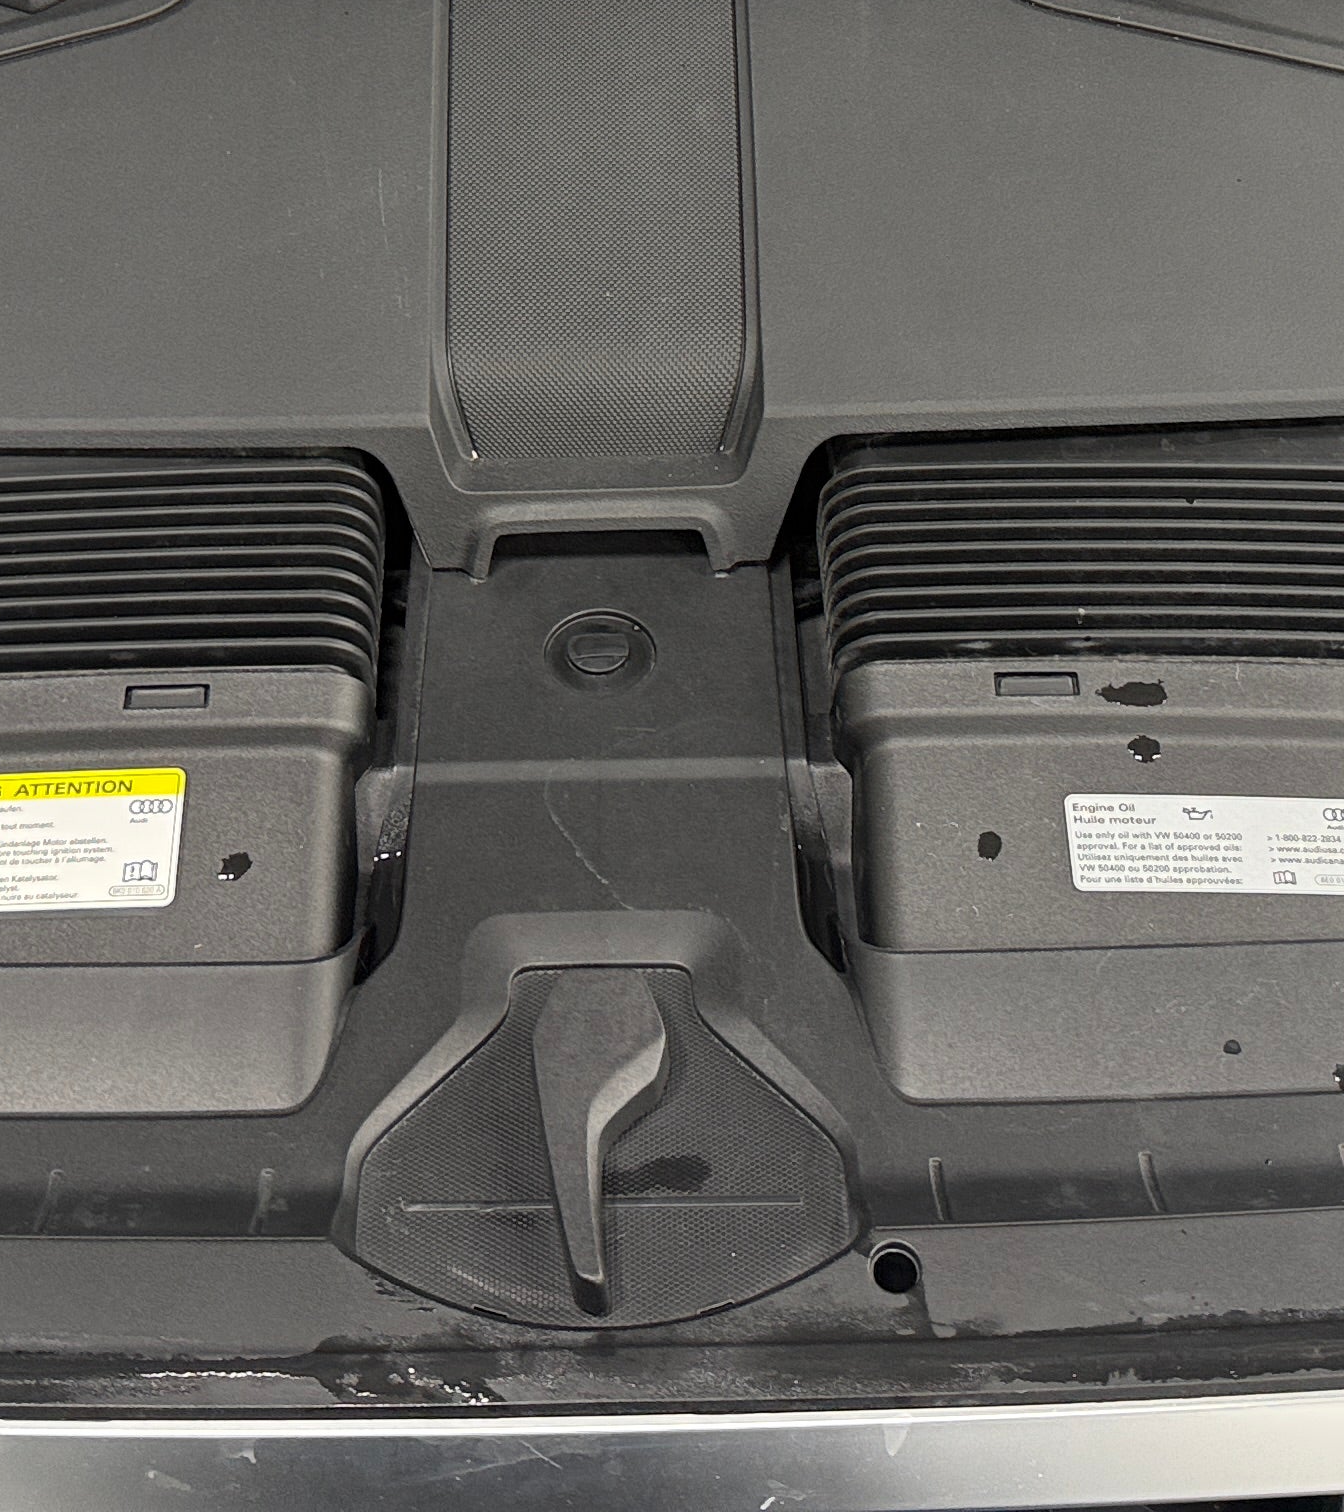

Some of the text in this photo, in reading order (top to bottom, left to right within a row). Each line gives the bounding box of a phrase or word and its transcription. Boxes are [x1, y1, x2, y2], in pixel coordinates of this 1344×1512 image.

[15, 780, 132, 797] ATTENTION
[1072, 802, 1135, 813] Engine Oil
[1073, 815, 1156, 824] Huile moteur
[1095, 831, 1115, 839] only
[1173, 831, 1200, 839] 50400
[1214, 832, 1242, 840] 50200
[1076, 841, 1119, 850] approval.
[1176, 842, 1220, 852] approved
[1114, 854, 1170, 863] uniquement
[1078, 863, 1095, 871] VW
[1097, 863, 1125, 872] 50400
[1142, 864, 1170, 872] 50200
[1172, 864, 1232, 874] approbation.
